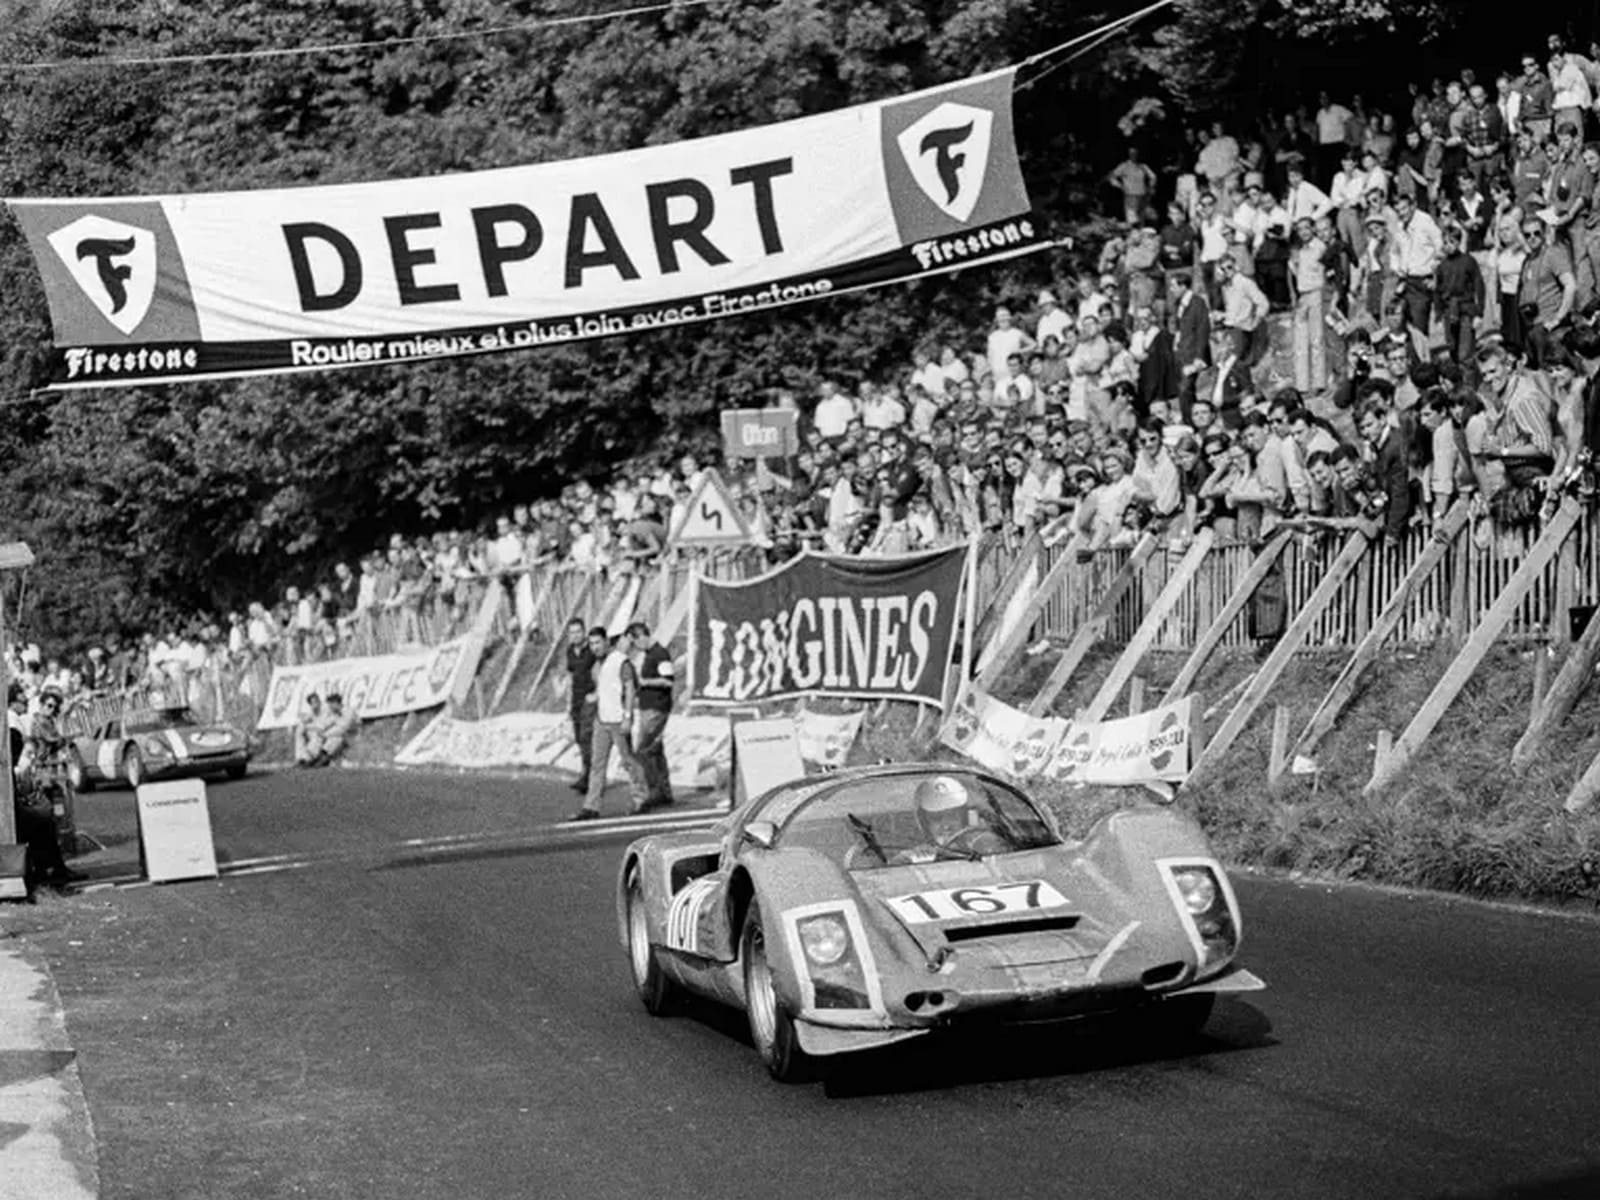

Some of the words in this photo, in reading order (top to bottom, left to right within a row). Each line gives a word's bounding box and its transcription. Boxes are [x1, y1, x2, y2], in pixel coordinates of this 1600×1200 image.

[281, 157, 793, 313] DEPART
[911, 220, 1034, 269] Firestone
[291, 340, 385, 365] Rouler
[388, 335, 475, 358] mieux
[479, 327, 508, 349] et
[511, 322, 572, 348] plus
[575, 313, 627, 337] loin
[631, 304, 697, 329] avec
[702, 279, 833, 316] Firestone
[64, 347, 198, 379] Firestone
[703, 590, 938, 699] LONGINES
[901, 882, 1041, 919] 167
